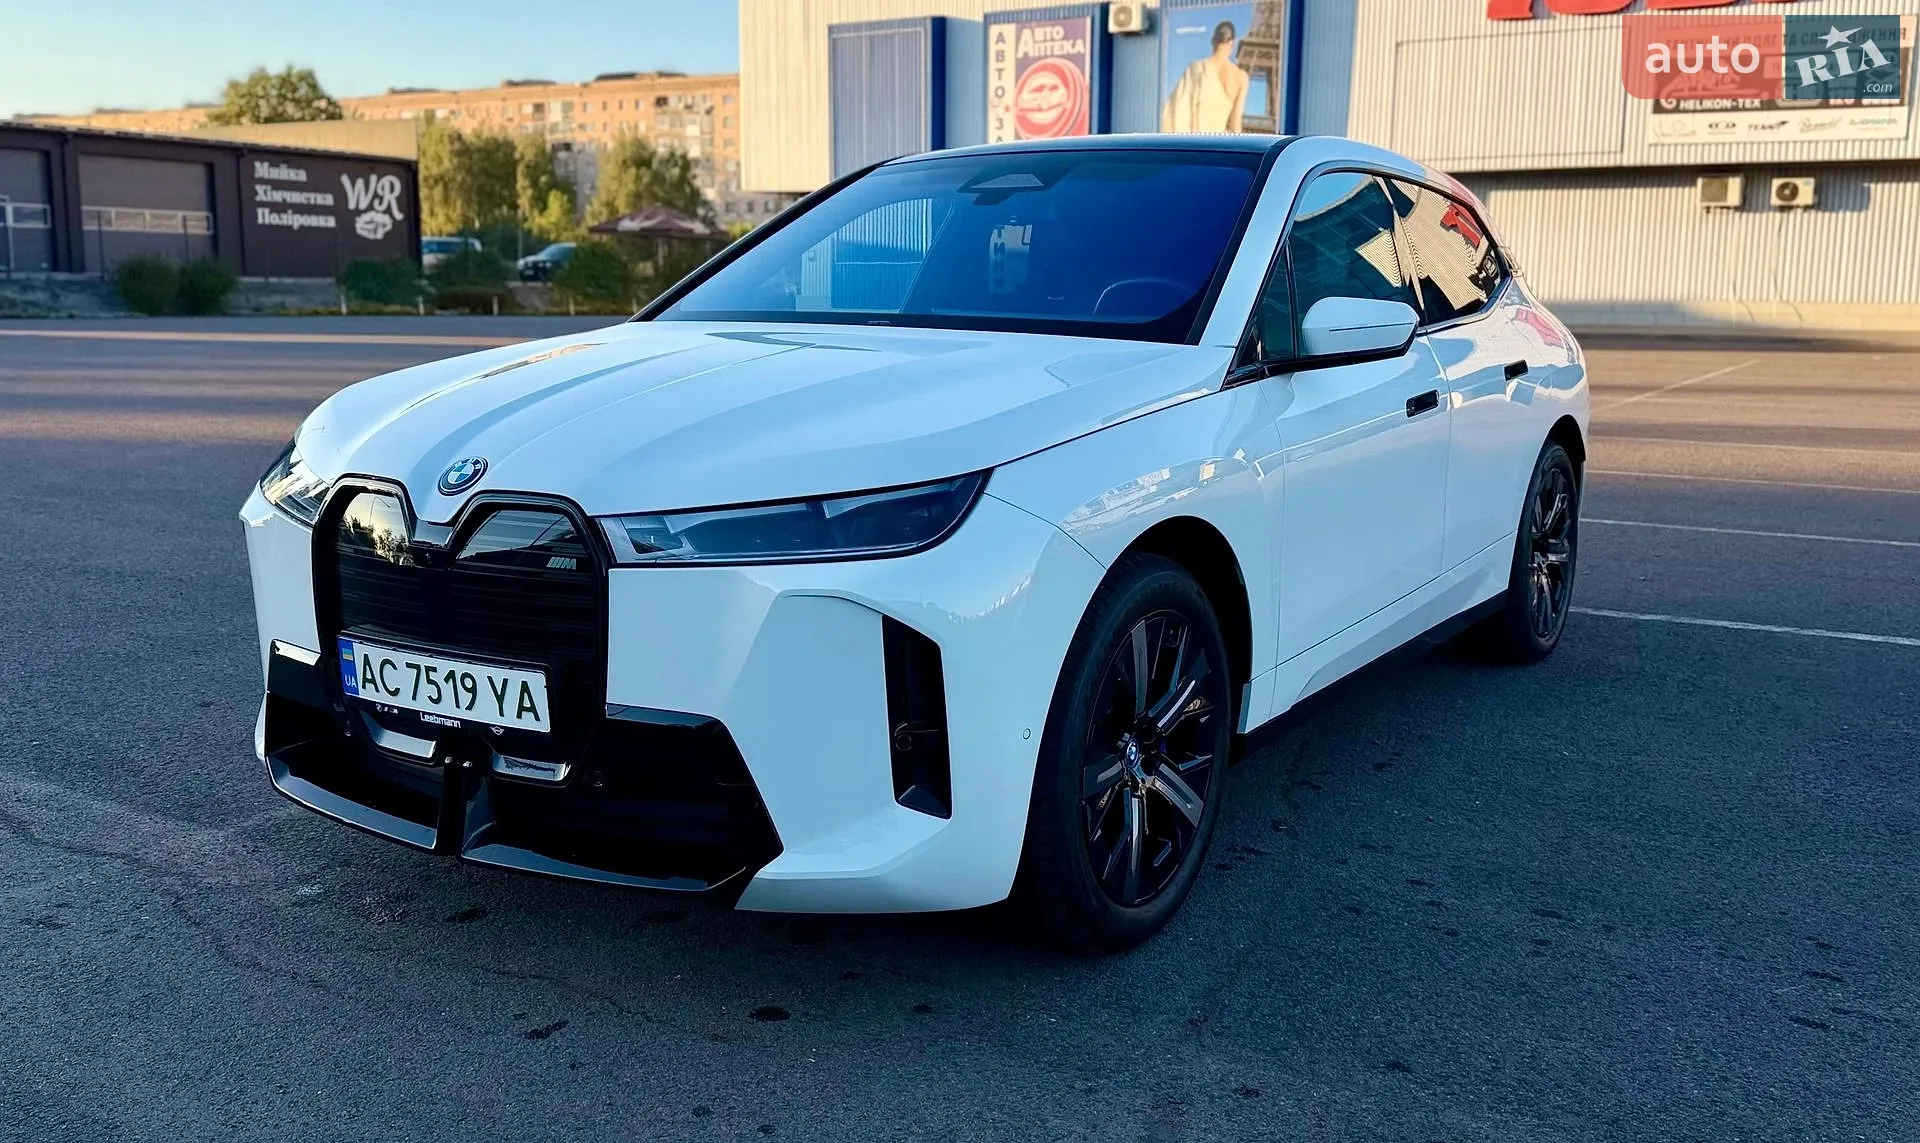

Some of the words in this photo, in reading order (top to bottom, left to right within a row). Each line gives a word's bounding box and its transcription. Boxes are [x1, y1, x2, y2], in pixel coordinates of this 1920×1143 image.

[254, 160, 308, 182] Мийка
[254, 184, 335, 206] Хімчистка
[340, 173, 404, 221] WR
[256, 207, 337, 230] Поліровка
[344, 674, 358, 689] UA
[360, 653, 401, 697] AC
[405, 661, 478, 711] 7519
[487, 675, 541, 722] YA
[420, 711, 461, 728] Leebmann
